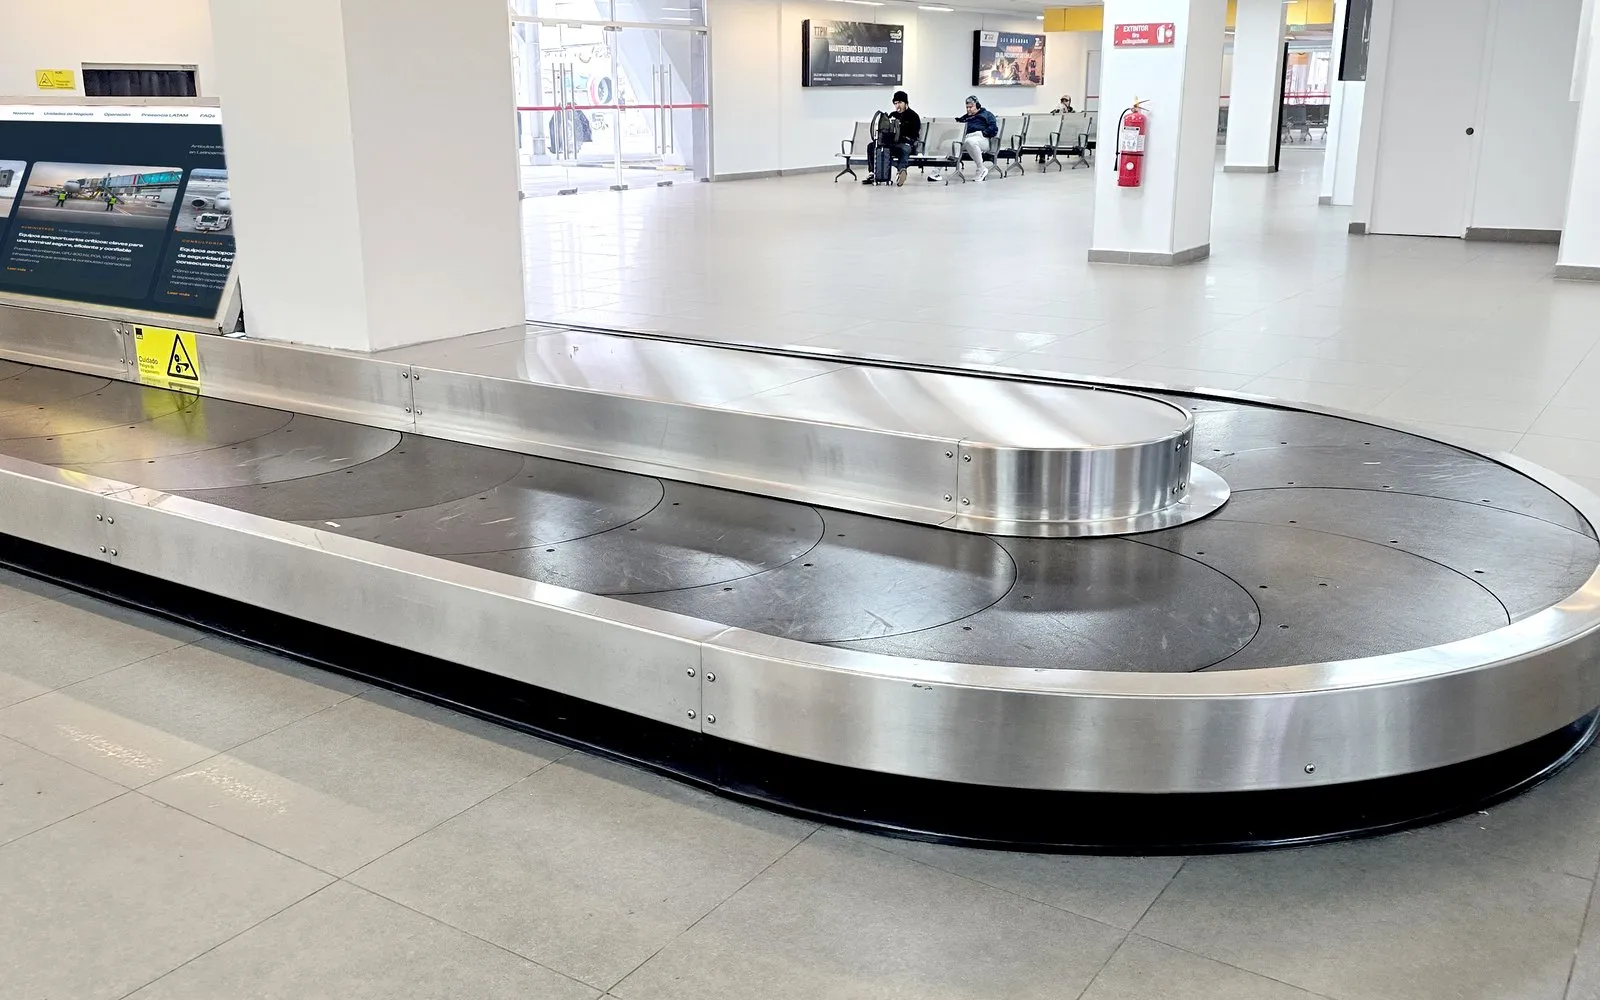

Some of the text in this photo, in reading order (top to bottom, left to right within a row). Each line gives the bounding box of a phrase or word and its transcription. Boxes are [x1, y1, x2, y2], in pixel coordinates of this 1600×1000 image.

[828, 44, 888, 54] MANTENEMOS EN MOVIMIENTO
[835, 55, 841, 63] LO
[841, 55, 850, 64] QUE
[850, 55, 864, 63] MUEVE
[869, 56, 883, 64] NORTE
[175, 260, 225, 268] consecuencias
[138, 355, 158, 365] Cuidado
